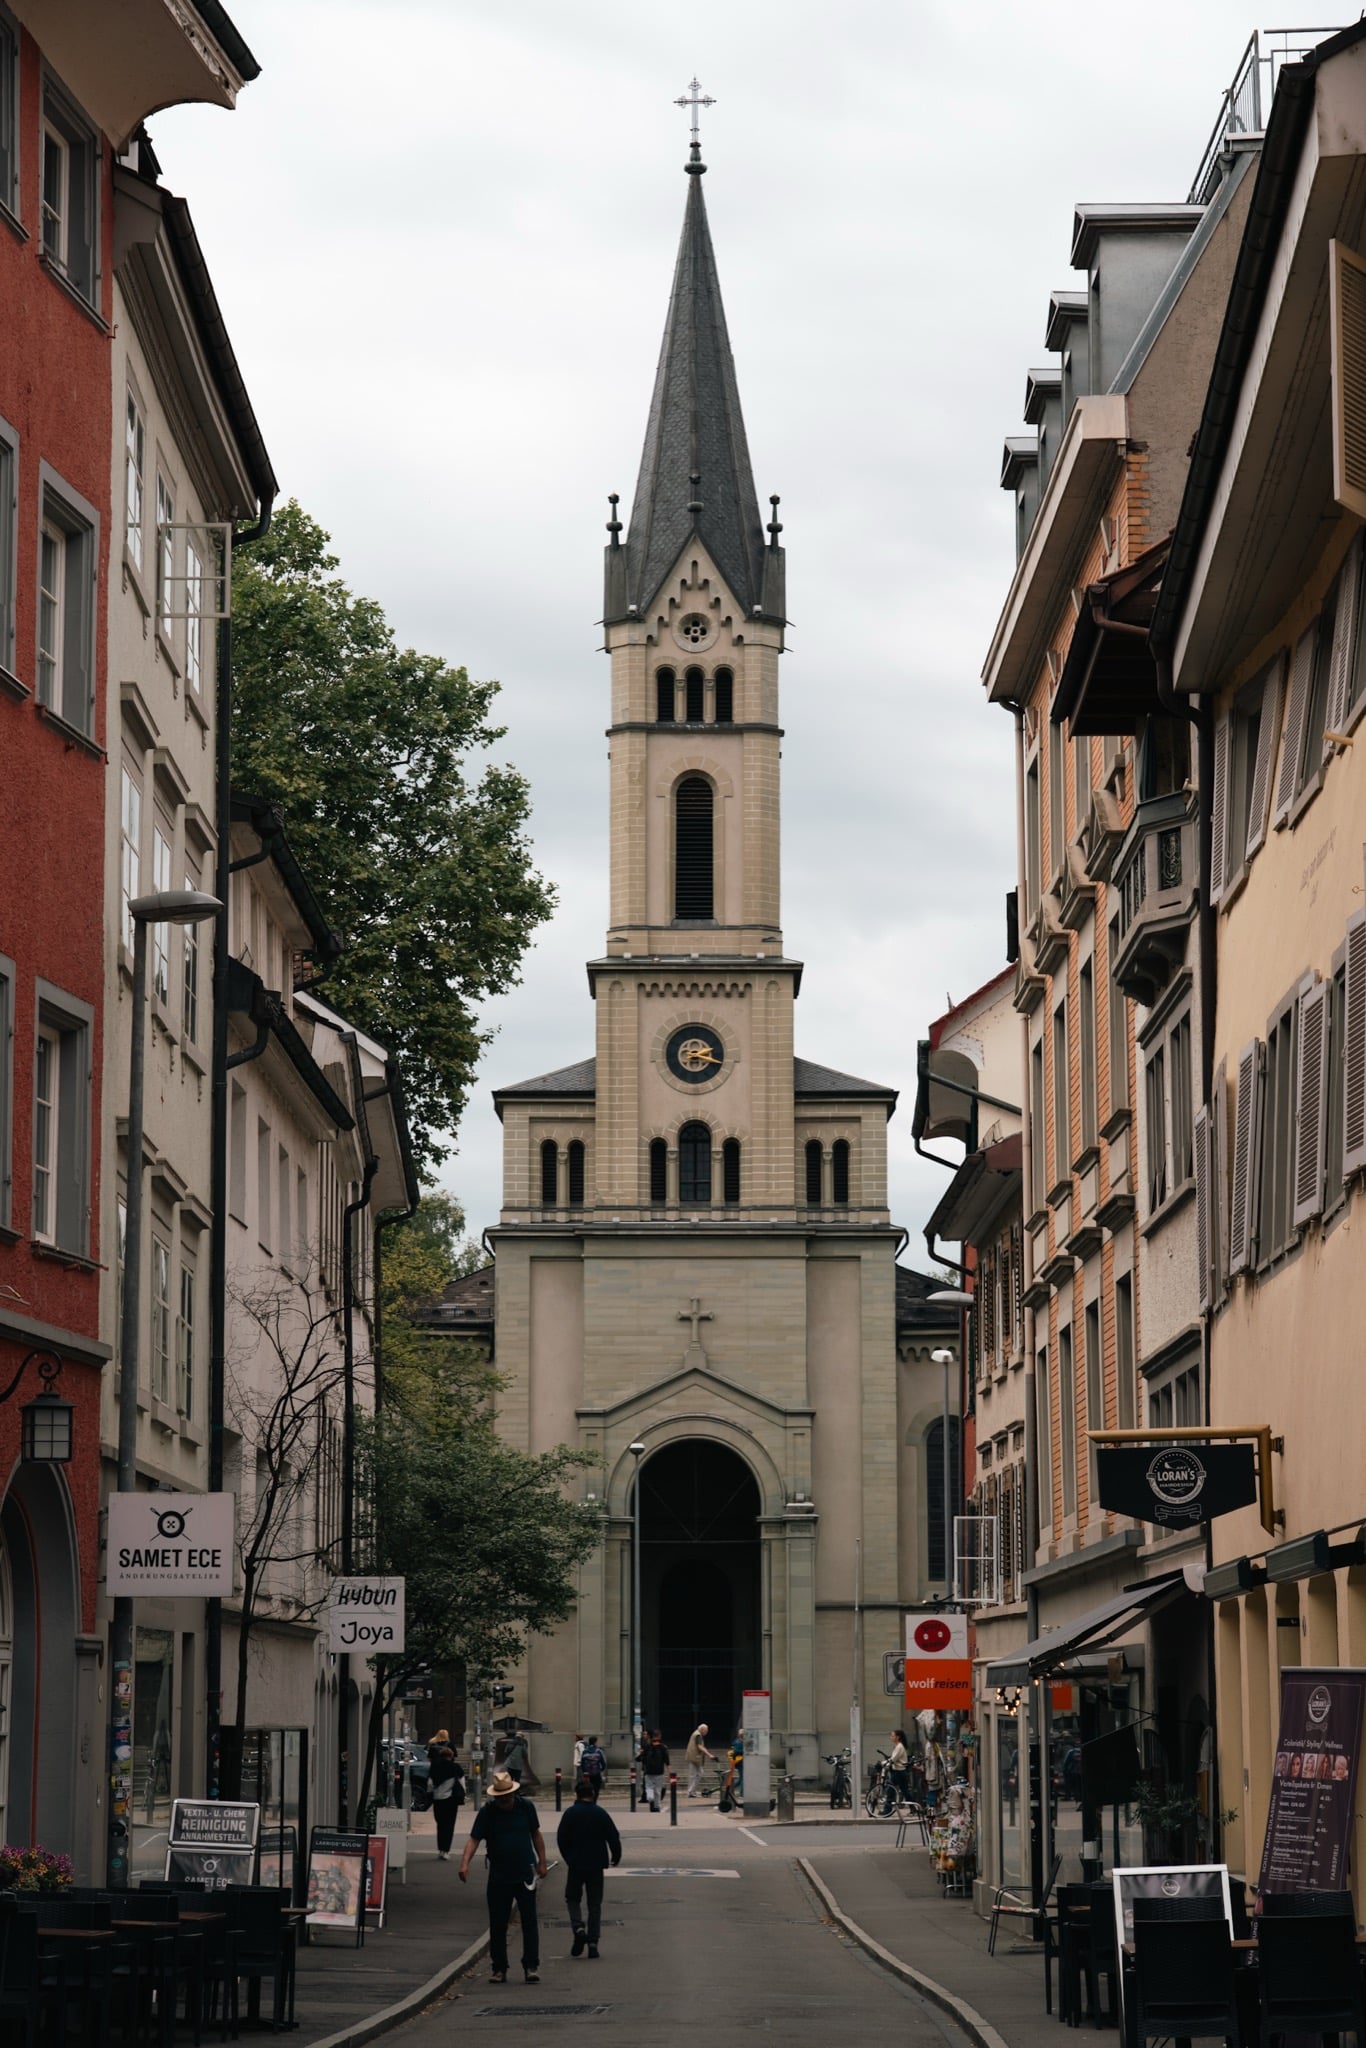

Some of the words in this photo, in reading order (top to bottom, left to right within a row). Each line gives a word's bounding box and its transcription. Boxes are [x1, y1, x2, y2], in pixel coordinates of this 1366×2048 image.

[1157, 1468, 1196, 1481] LORAN'S
[119, 1548, 183, 1568] SAMET
[188, 1549, 221, 1568] ECE
[339, 1584, 396, 1605] kybun
[340, 1621, 393, 1645] Joya
[908, 1677, 968, 1689] wolfreisen
[183, 1808, 212, 1817] TEXTIL-
[213, 1809, 221, 1817] U.
[223, 1809, 247, 1818] CHEM.
[181, 1818, 247, 1832] REINIGUNG
[180, 1832, 247, 1841] ANNAHMESTELLE
